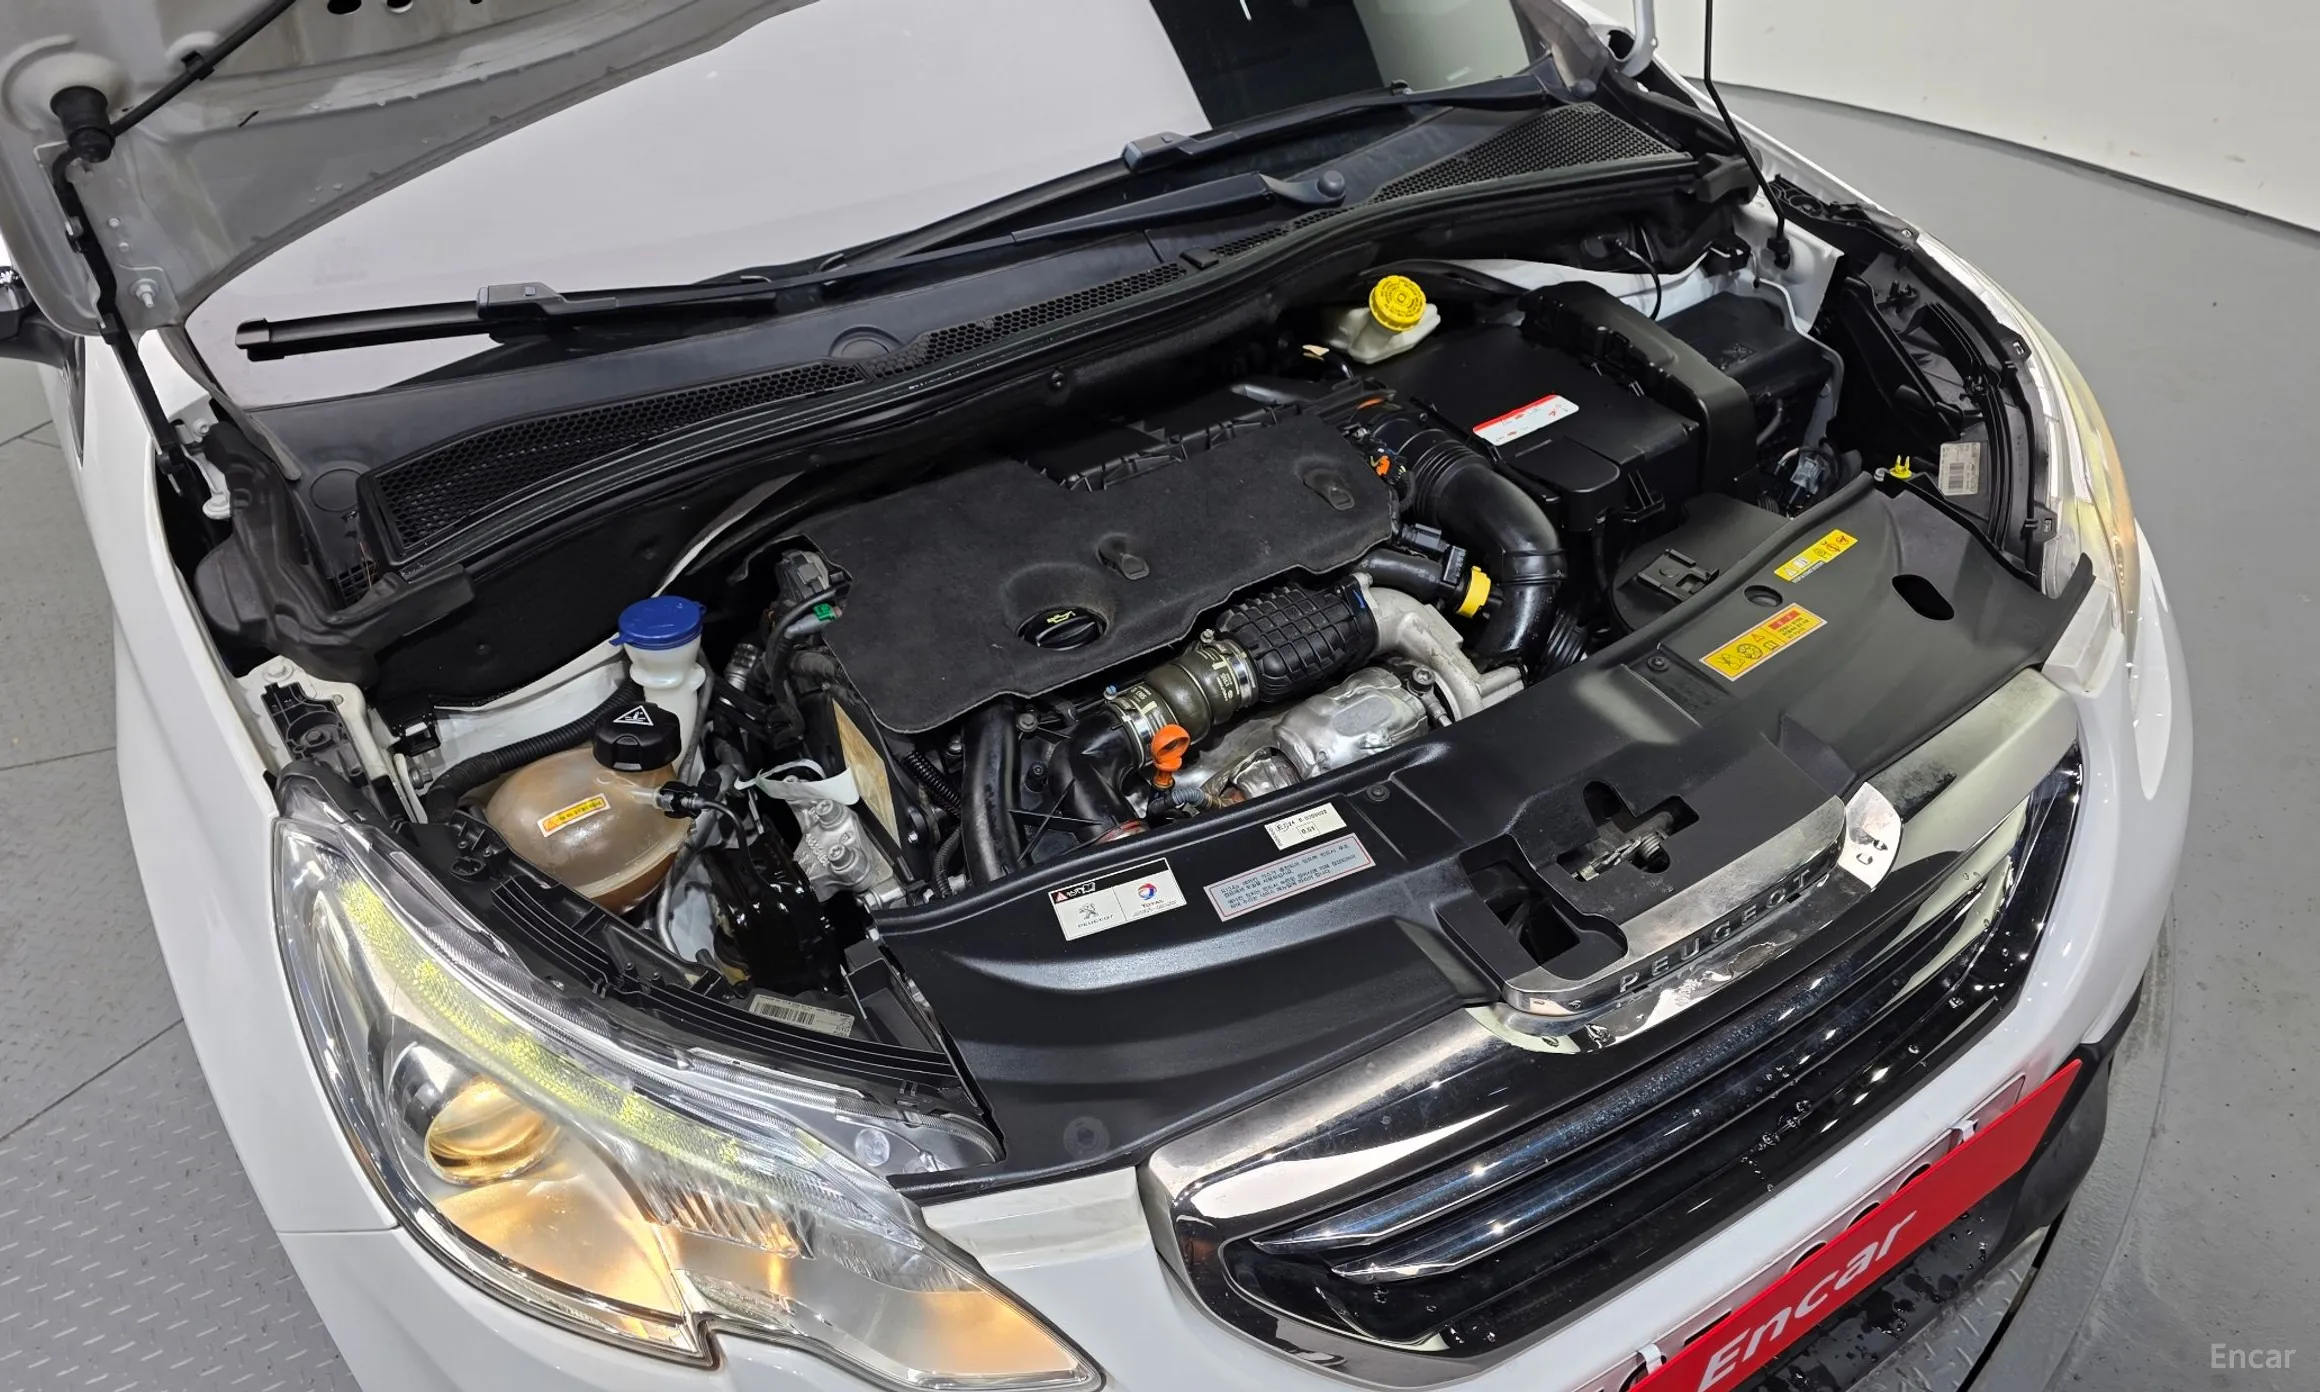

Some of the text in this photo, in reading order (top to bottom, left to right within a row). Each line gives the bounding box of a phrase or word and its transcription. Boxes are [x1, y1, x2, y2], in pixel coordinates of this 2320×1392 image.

[1077, 914, 1114, 928] PEUGEOT
[1619, 869, 1811, 993] PEUGEOT
[1697, 1210, 1917, 1392] Encar
